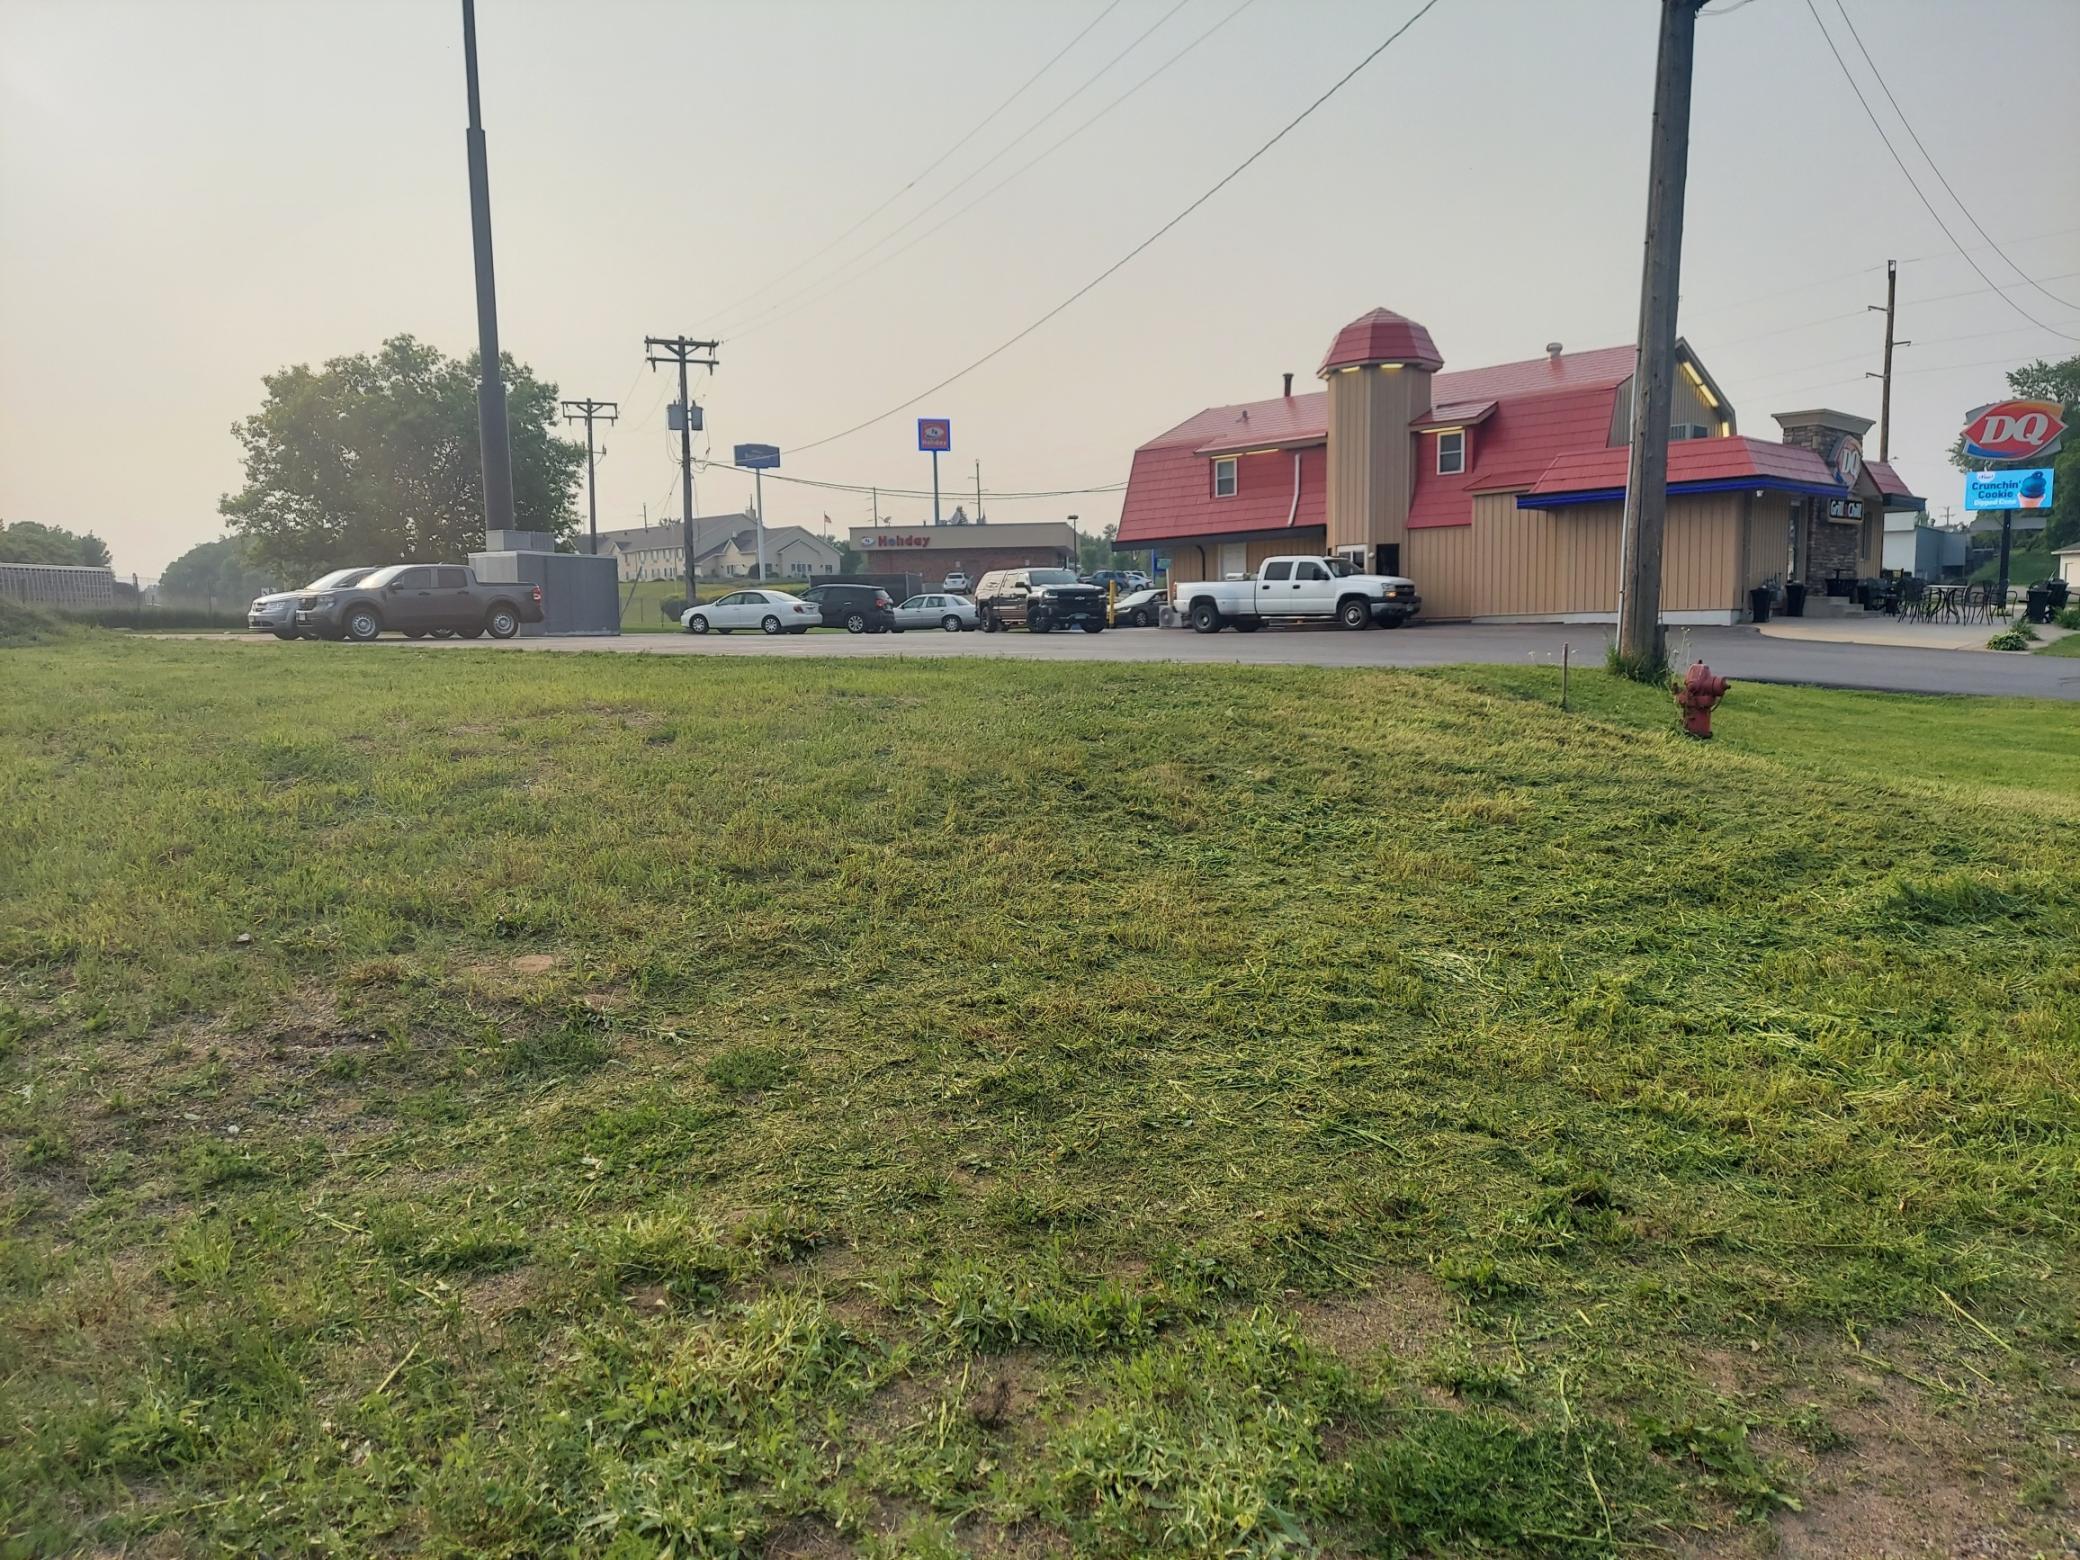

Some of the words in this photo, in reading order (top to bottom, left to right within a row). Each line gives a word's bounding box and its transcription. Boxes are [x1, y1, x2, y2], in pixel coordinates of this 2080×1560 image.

[1979, 412, 2048, 446] DQ
[1841, 448, 1861, 476] DQ
[1972, 480, 2021, 490] Crunchin'
[1978, 489, 2014, 499] Cookie
